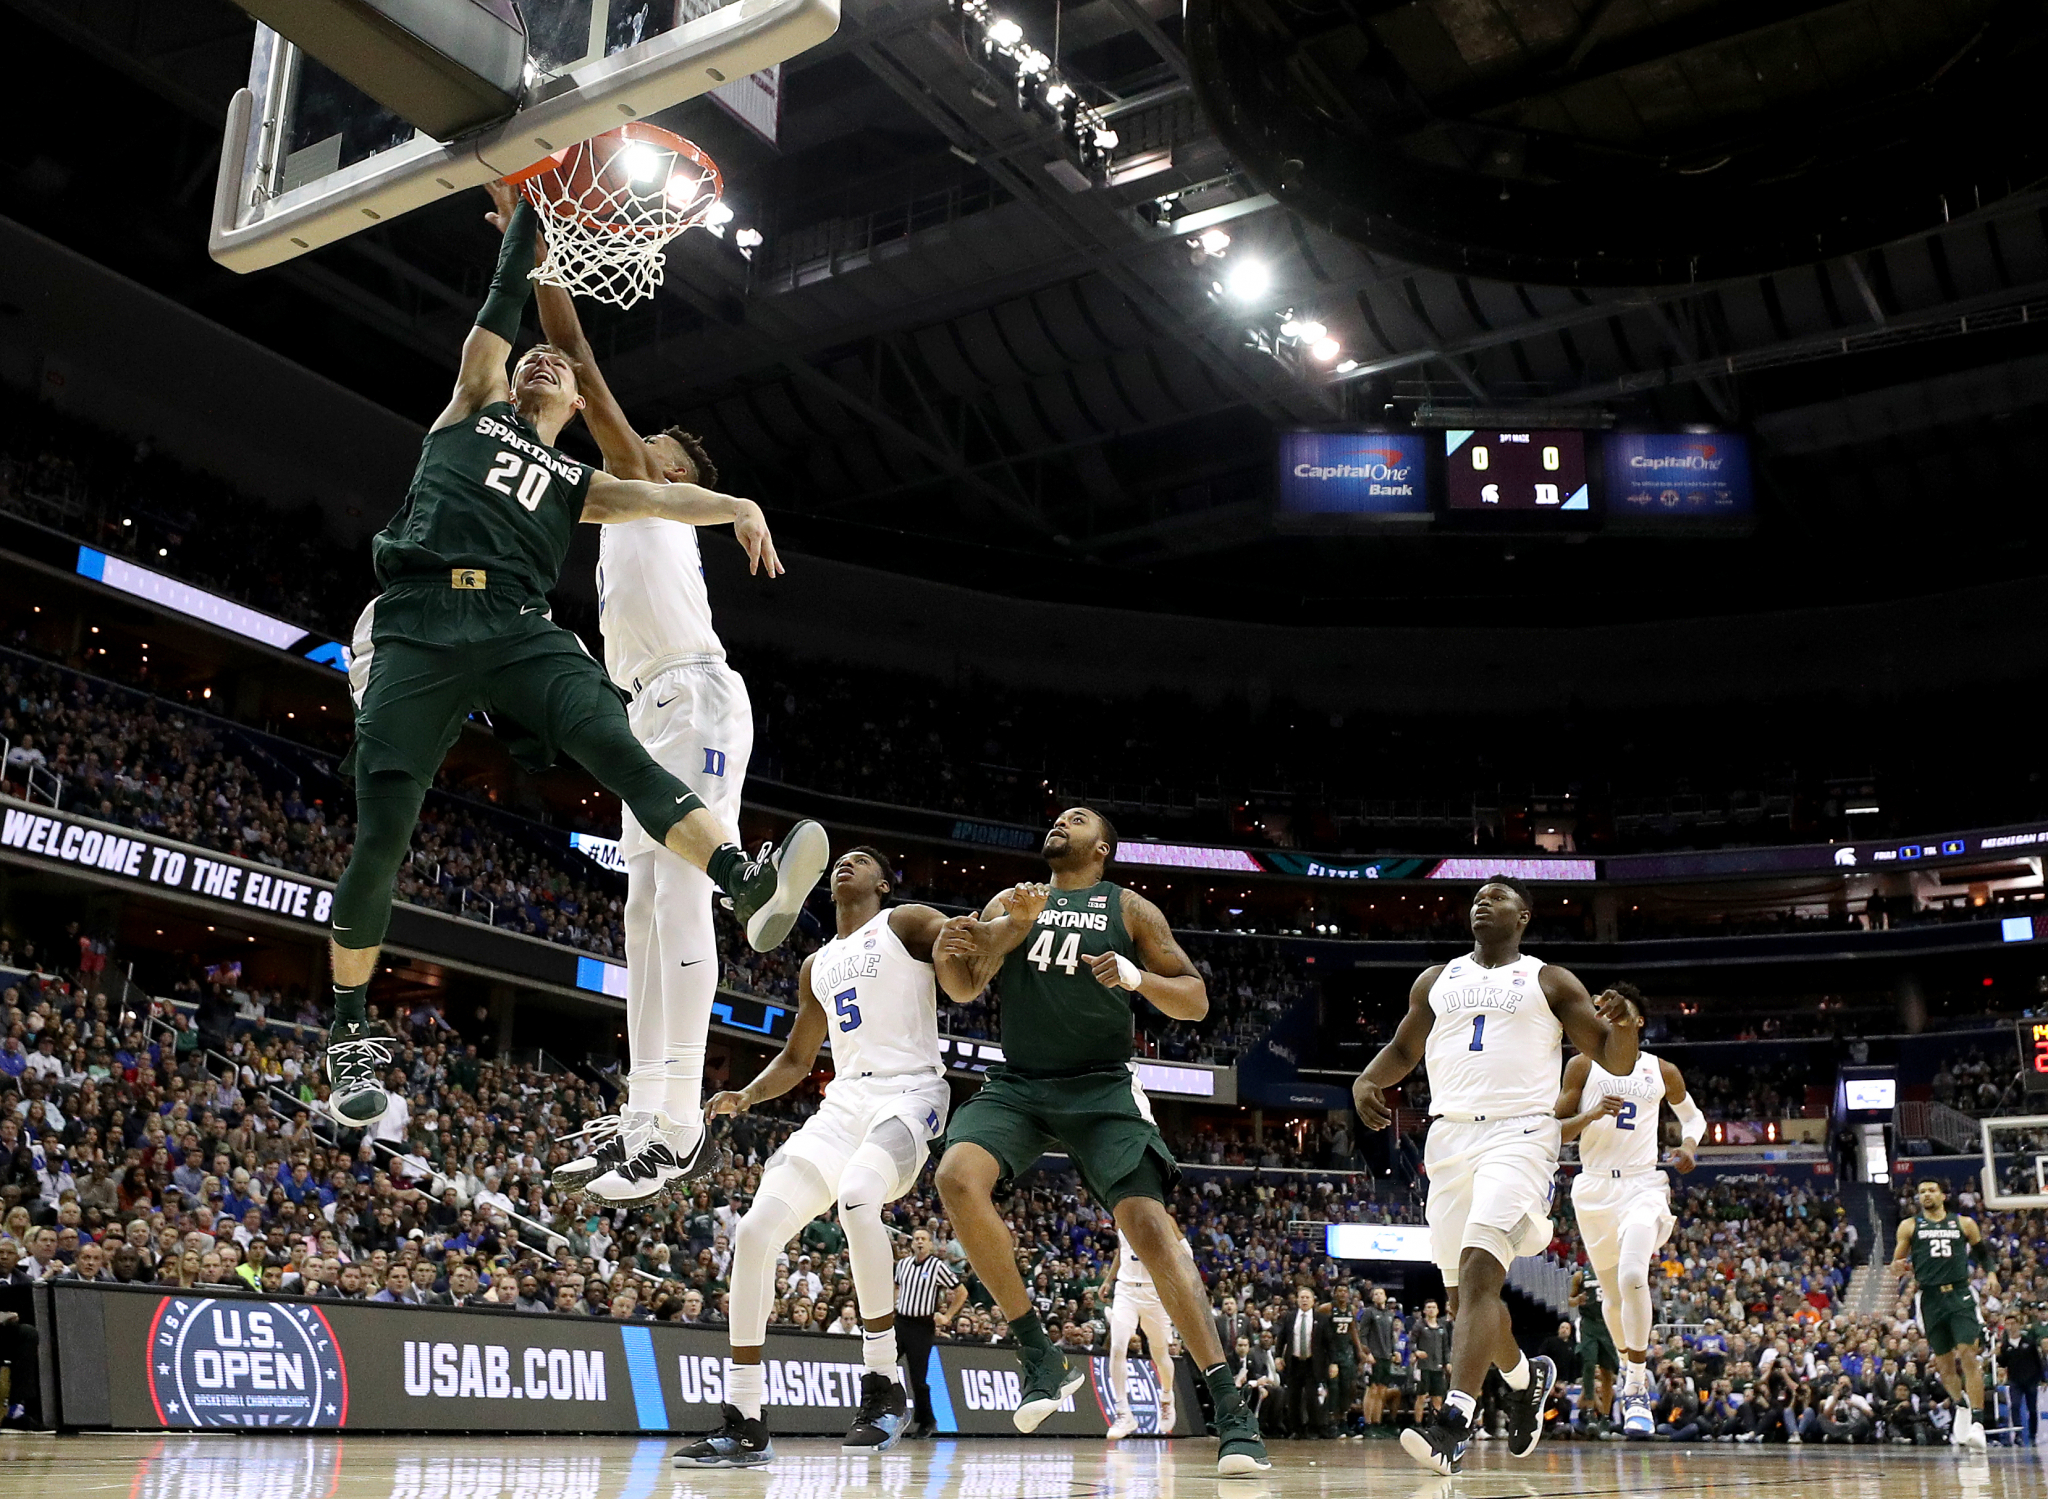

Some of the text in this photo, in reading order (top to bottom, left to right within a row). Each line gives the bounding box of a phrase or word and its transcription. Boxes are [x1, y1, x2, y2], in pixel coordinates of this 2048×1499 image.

[475, 416, 583, 486] SPARTANS
[1472, 446, 1489, 470] 0
[1543, 446, 1560, 470] 0
[484, 451, 551, 512] 20
[1369, 484, 1414, 496] Bank
[1980, 833, 2037, 849] MICHIGAN
[0, 808, 333, 923] WELCOME TO THE ELITE 8
[1037, 909, 1109, 932] ARTANS
[1027, 929, 1082, 976] 44
[815, 953, 881, 1003] DUKE
[833, 986, 863, 1033] 5
[1442, 986, 1524, 1015] DUKE
[1468, 1014, 1486, 1052] 1
[1598, 1078, 1658, 1103] DUKE
[1615, 1101, 1637, 1131] 2
[1917, 1229, 1961, 1239] SPARTANS
[1929, 1239, 1952, 1257] 25
[212, 1309, 284, 1349] U.S.
[1336, 1323, 1349, 1334] 23
[193, 1349, 306, 1391] OPEN
[404, 1340, 607, 1401] USAB.COM
[193, 1394, 311, 1409] BASKETBALL CHAMPIONSHIPS
